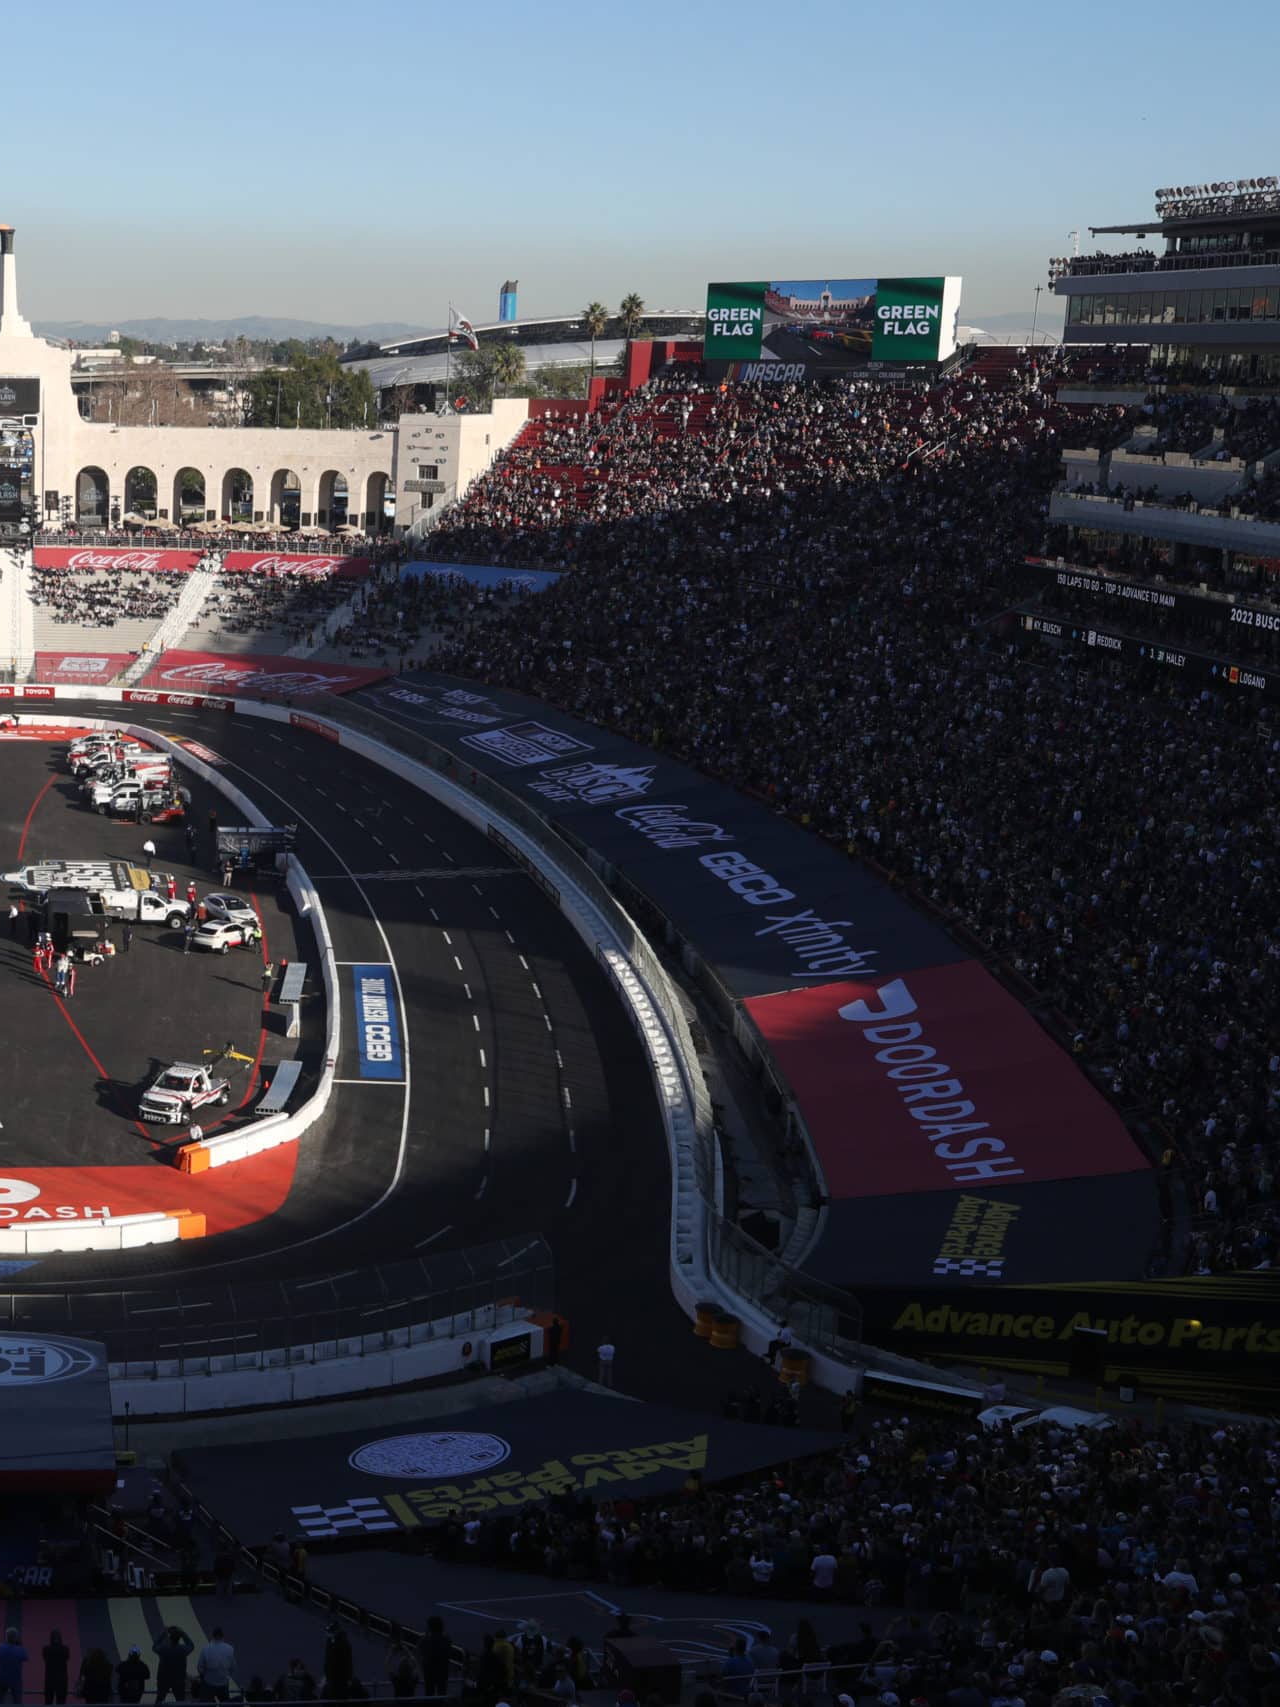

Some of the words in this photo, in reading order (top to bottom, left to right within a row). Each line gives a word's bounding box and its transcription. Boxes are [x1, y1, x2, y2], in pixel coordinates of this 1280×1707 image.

[707, 307, 761, 321] GREEN
[877, 304, 939, 320] GREEN
[713, 323, 754, 336] FLAG
[883, 321, 930, 335] FLAG
[743, 363, 806, 383] NASCAR
[69, 551, 166, 569] Coca-Cola
[1067, 575, 1083, 589] LAPS
[1083, 577, 1091, 589] TO
[1091, 578, 1100, 591] GO
[1105, 582, 1117, 595] TOP
[1122, 585, 1150, 602] ADVANCE
[1151, 589, 1159, 603] TO
[1160, 591, 1176, 607] MAIN
[1043, 622, 1063, 636] BUSCH
[1231, 608, 1254, 625] 2022
[1256, 613, 1280, 631] BUSC
[1096, 635, 1122, 651] REDDICK
[1166, 653, 1187, 667] HALEY
[1239, 671, 1266, 689] LOGANO
[25, 688, 50, 696] TOYOTA
[698, 851, 796, 905] GEICO
[365, 1024, 393, 1062] GEICO
[863, 1021, 1024, 1182] DOORDASH
[973, 1199, 1022, 1257] Advance
[892, 1302, 1056, 1340] Advance
[1058, 1311, 1166, 1346] Auto
[1167, 1316, 1280, 1353] Parts
[570, 1433, 709, 1466] Auto
[421, 1451, 708, 1519] Advance
